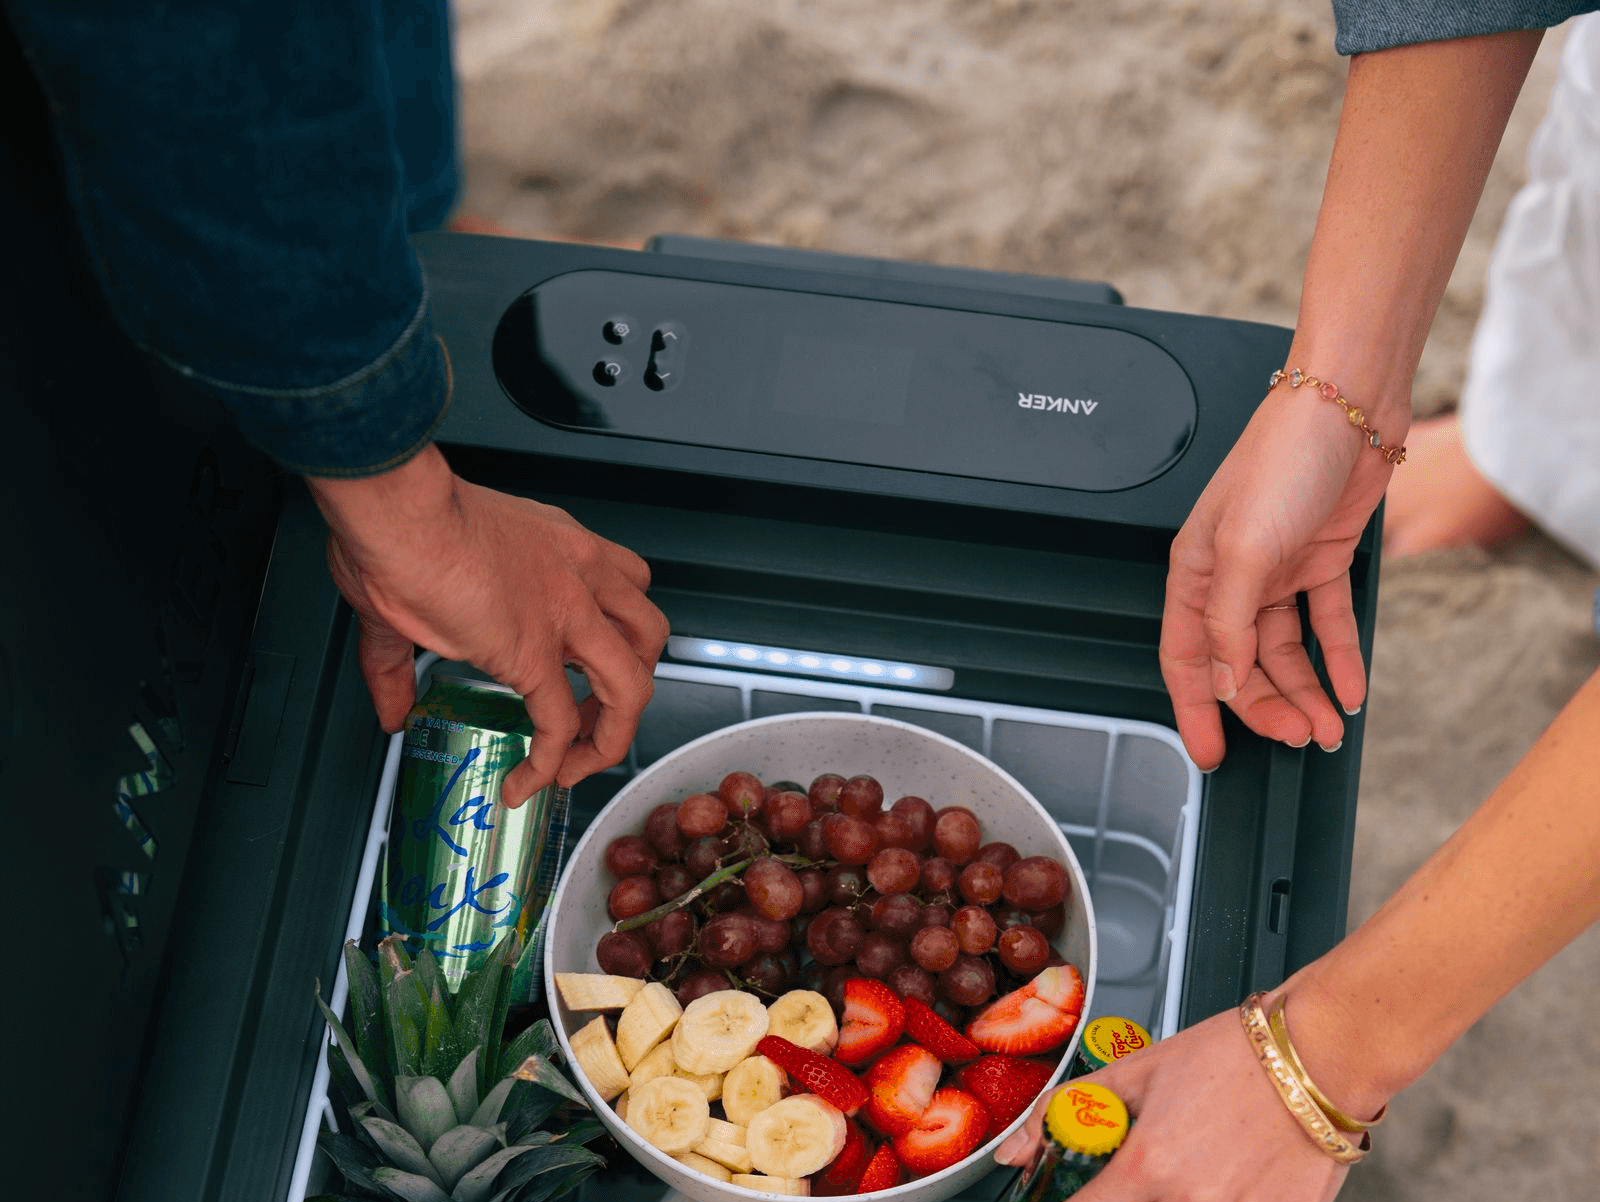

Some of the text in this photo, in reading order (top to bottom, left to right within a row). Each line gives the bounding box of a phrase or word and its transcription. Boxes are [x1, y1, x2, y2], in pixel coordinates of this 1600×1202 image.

[1018, 392, 1099, 415] ANKER
[412, 747, 496, 858] La
[1111, 1030, 1132, 1059] Topo
[1124, 1022, 1145, 1050] Chico
[1067, 1088, 1112, 1110] Topo
[1075, 1106, 1120, 1129] Chico
